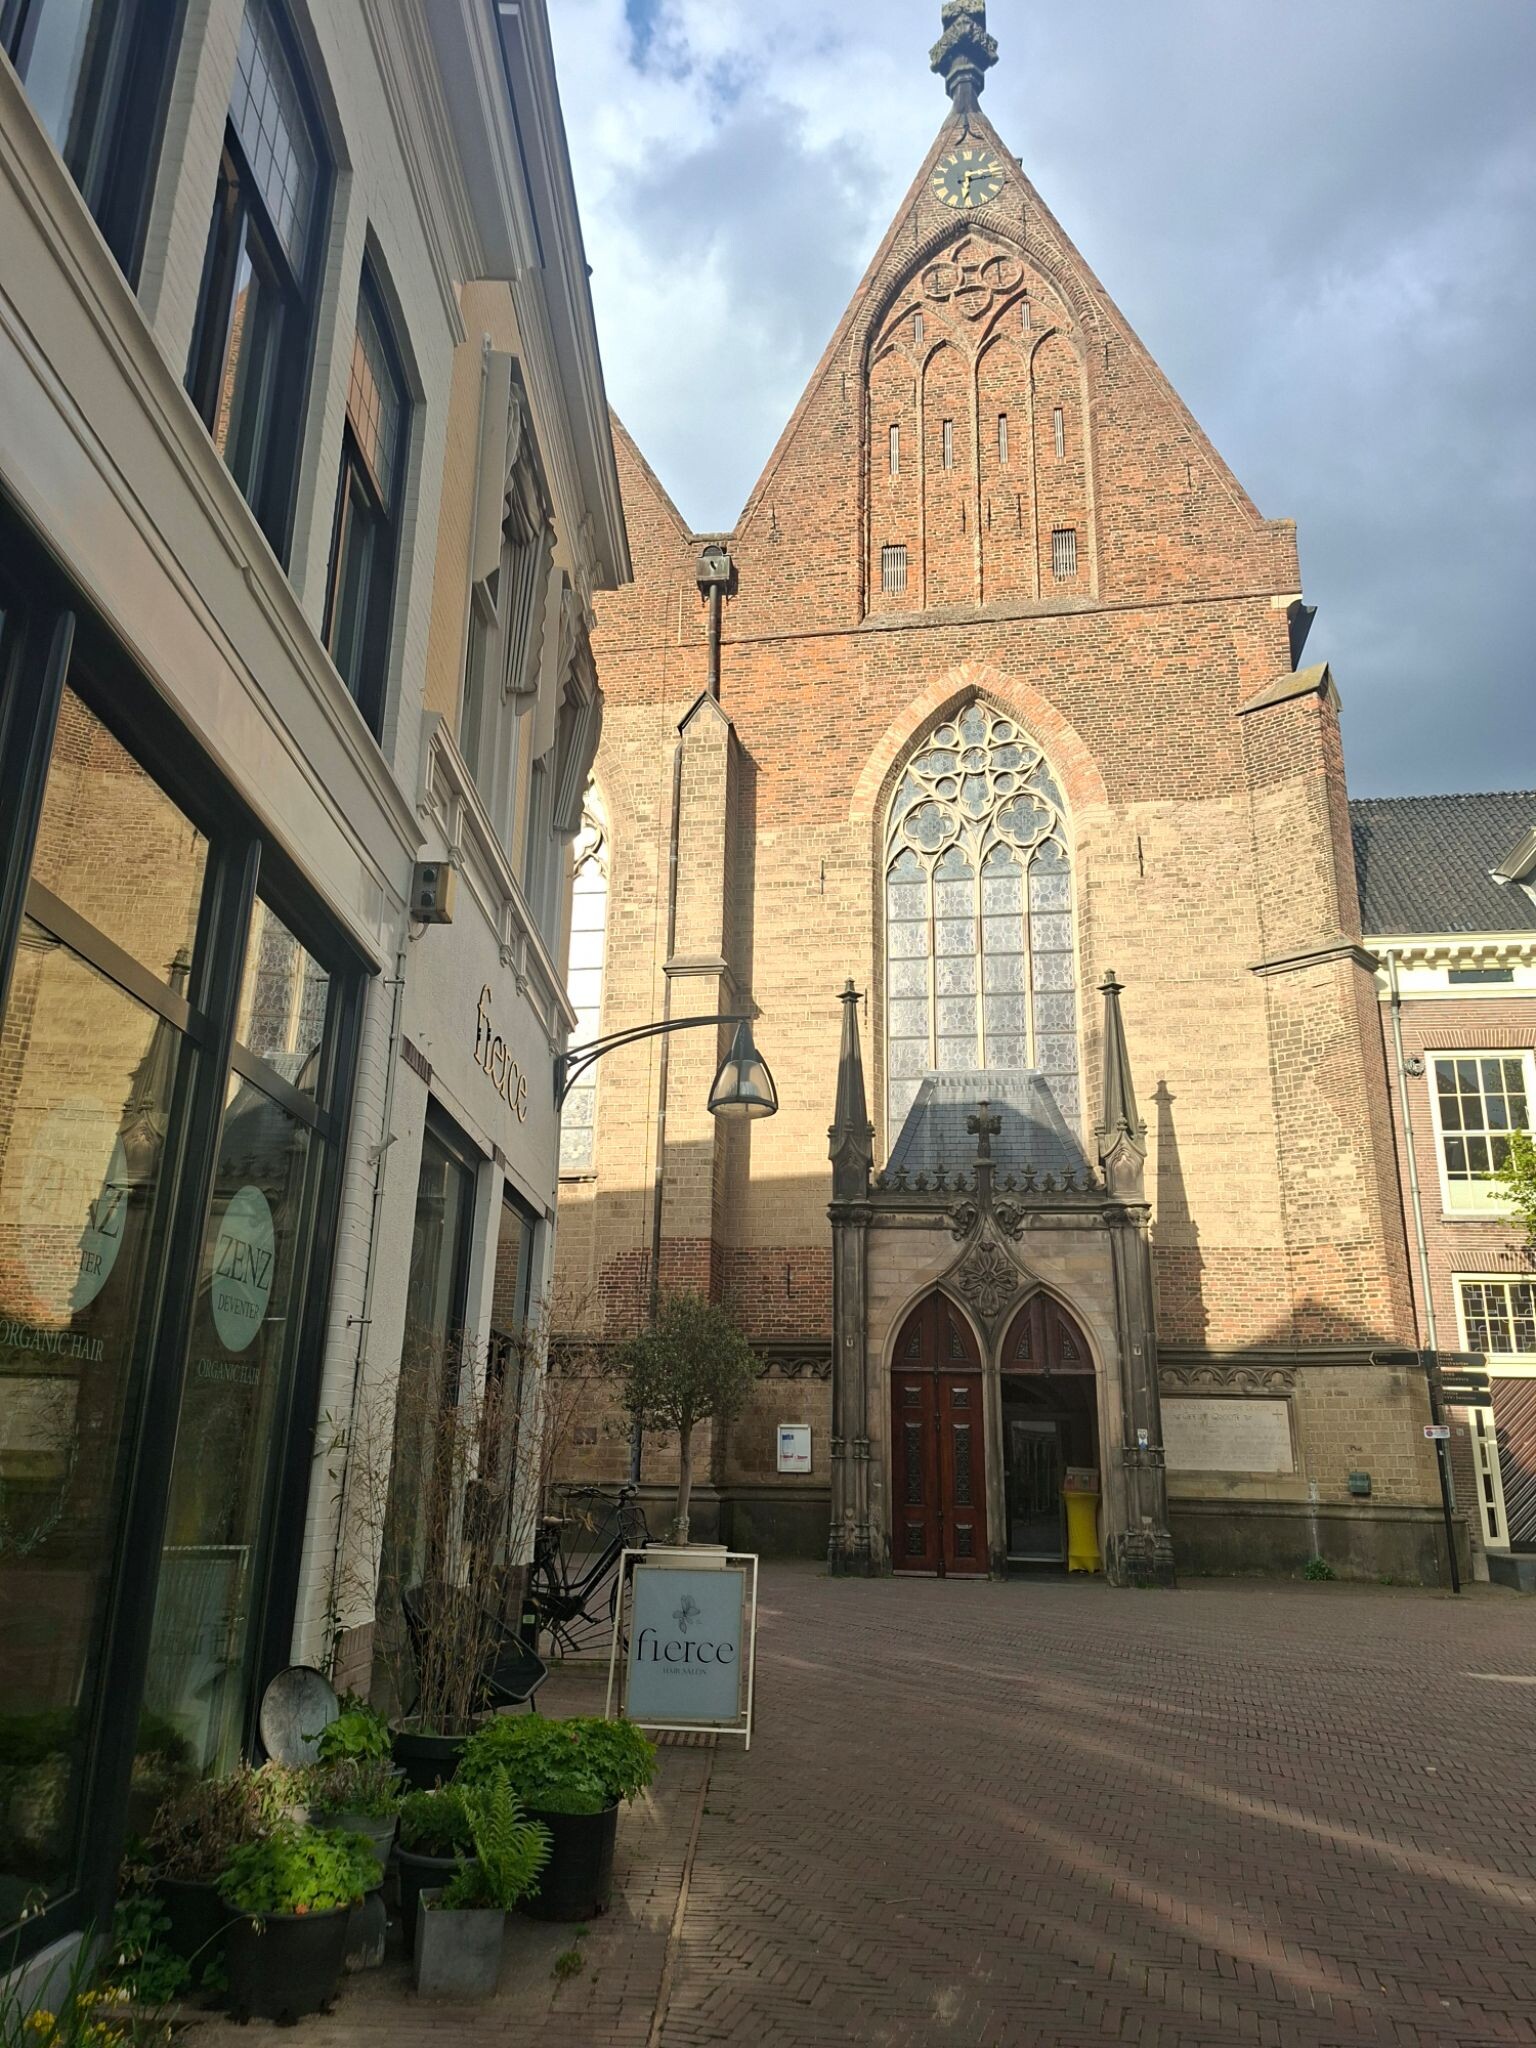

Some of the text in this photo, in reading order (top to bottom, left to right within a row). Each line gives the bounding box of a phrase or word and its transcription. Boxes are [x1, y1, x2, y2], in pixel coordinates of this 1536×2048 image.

[474, 984, 528, 1123] fierce
[216, 1234, 272, 1291] ZENZ
[217, 1294, 260, 1320] DEVENTER
[0, 1320, 104, 1362] ORGANIC HAIR
[635, 1628, 736, 1664] fierce
